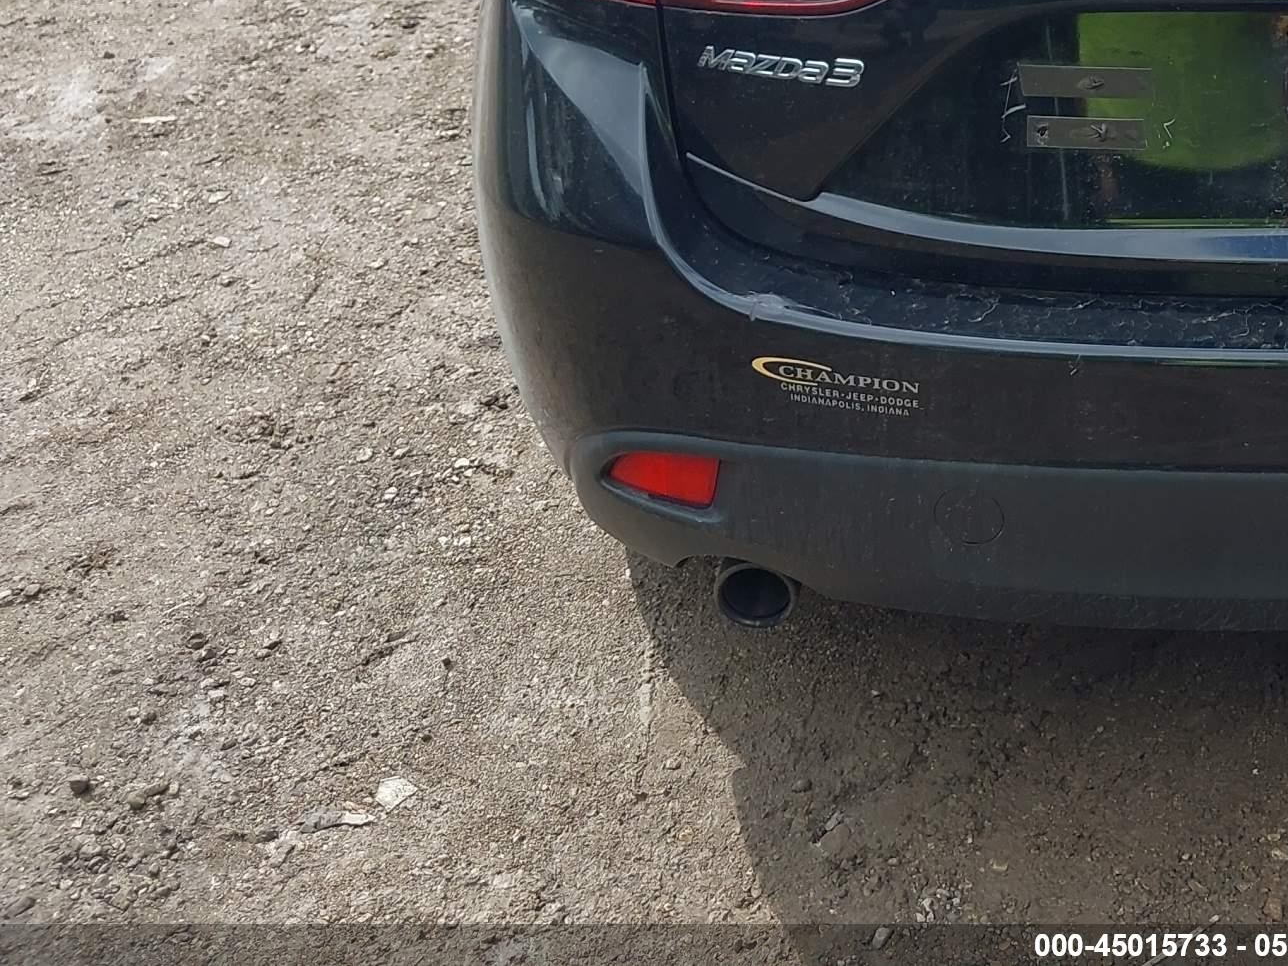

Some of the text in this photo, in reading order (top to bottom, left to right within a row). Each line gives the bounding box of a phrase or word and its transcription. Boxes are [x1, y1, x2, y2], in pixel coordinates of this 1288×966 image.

[778, 365, 920, 394] CHAMPION
[790, 393, 910, 417] INDIANAPOLIS, INDIANA
